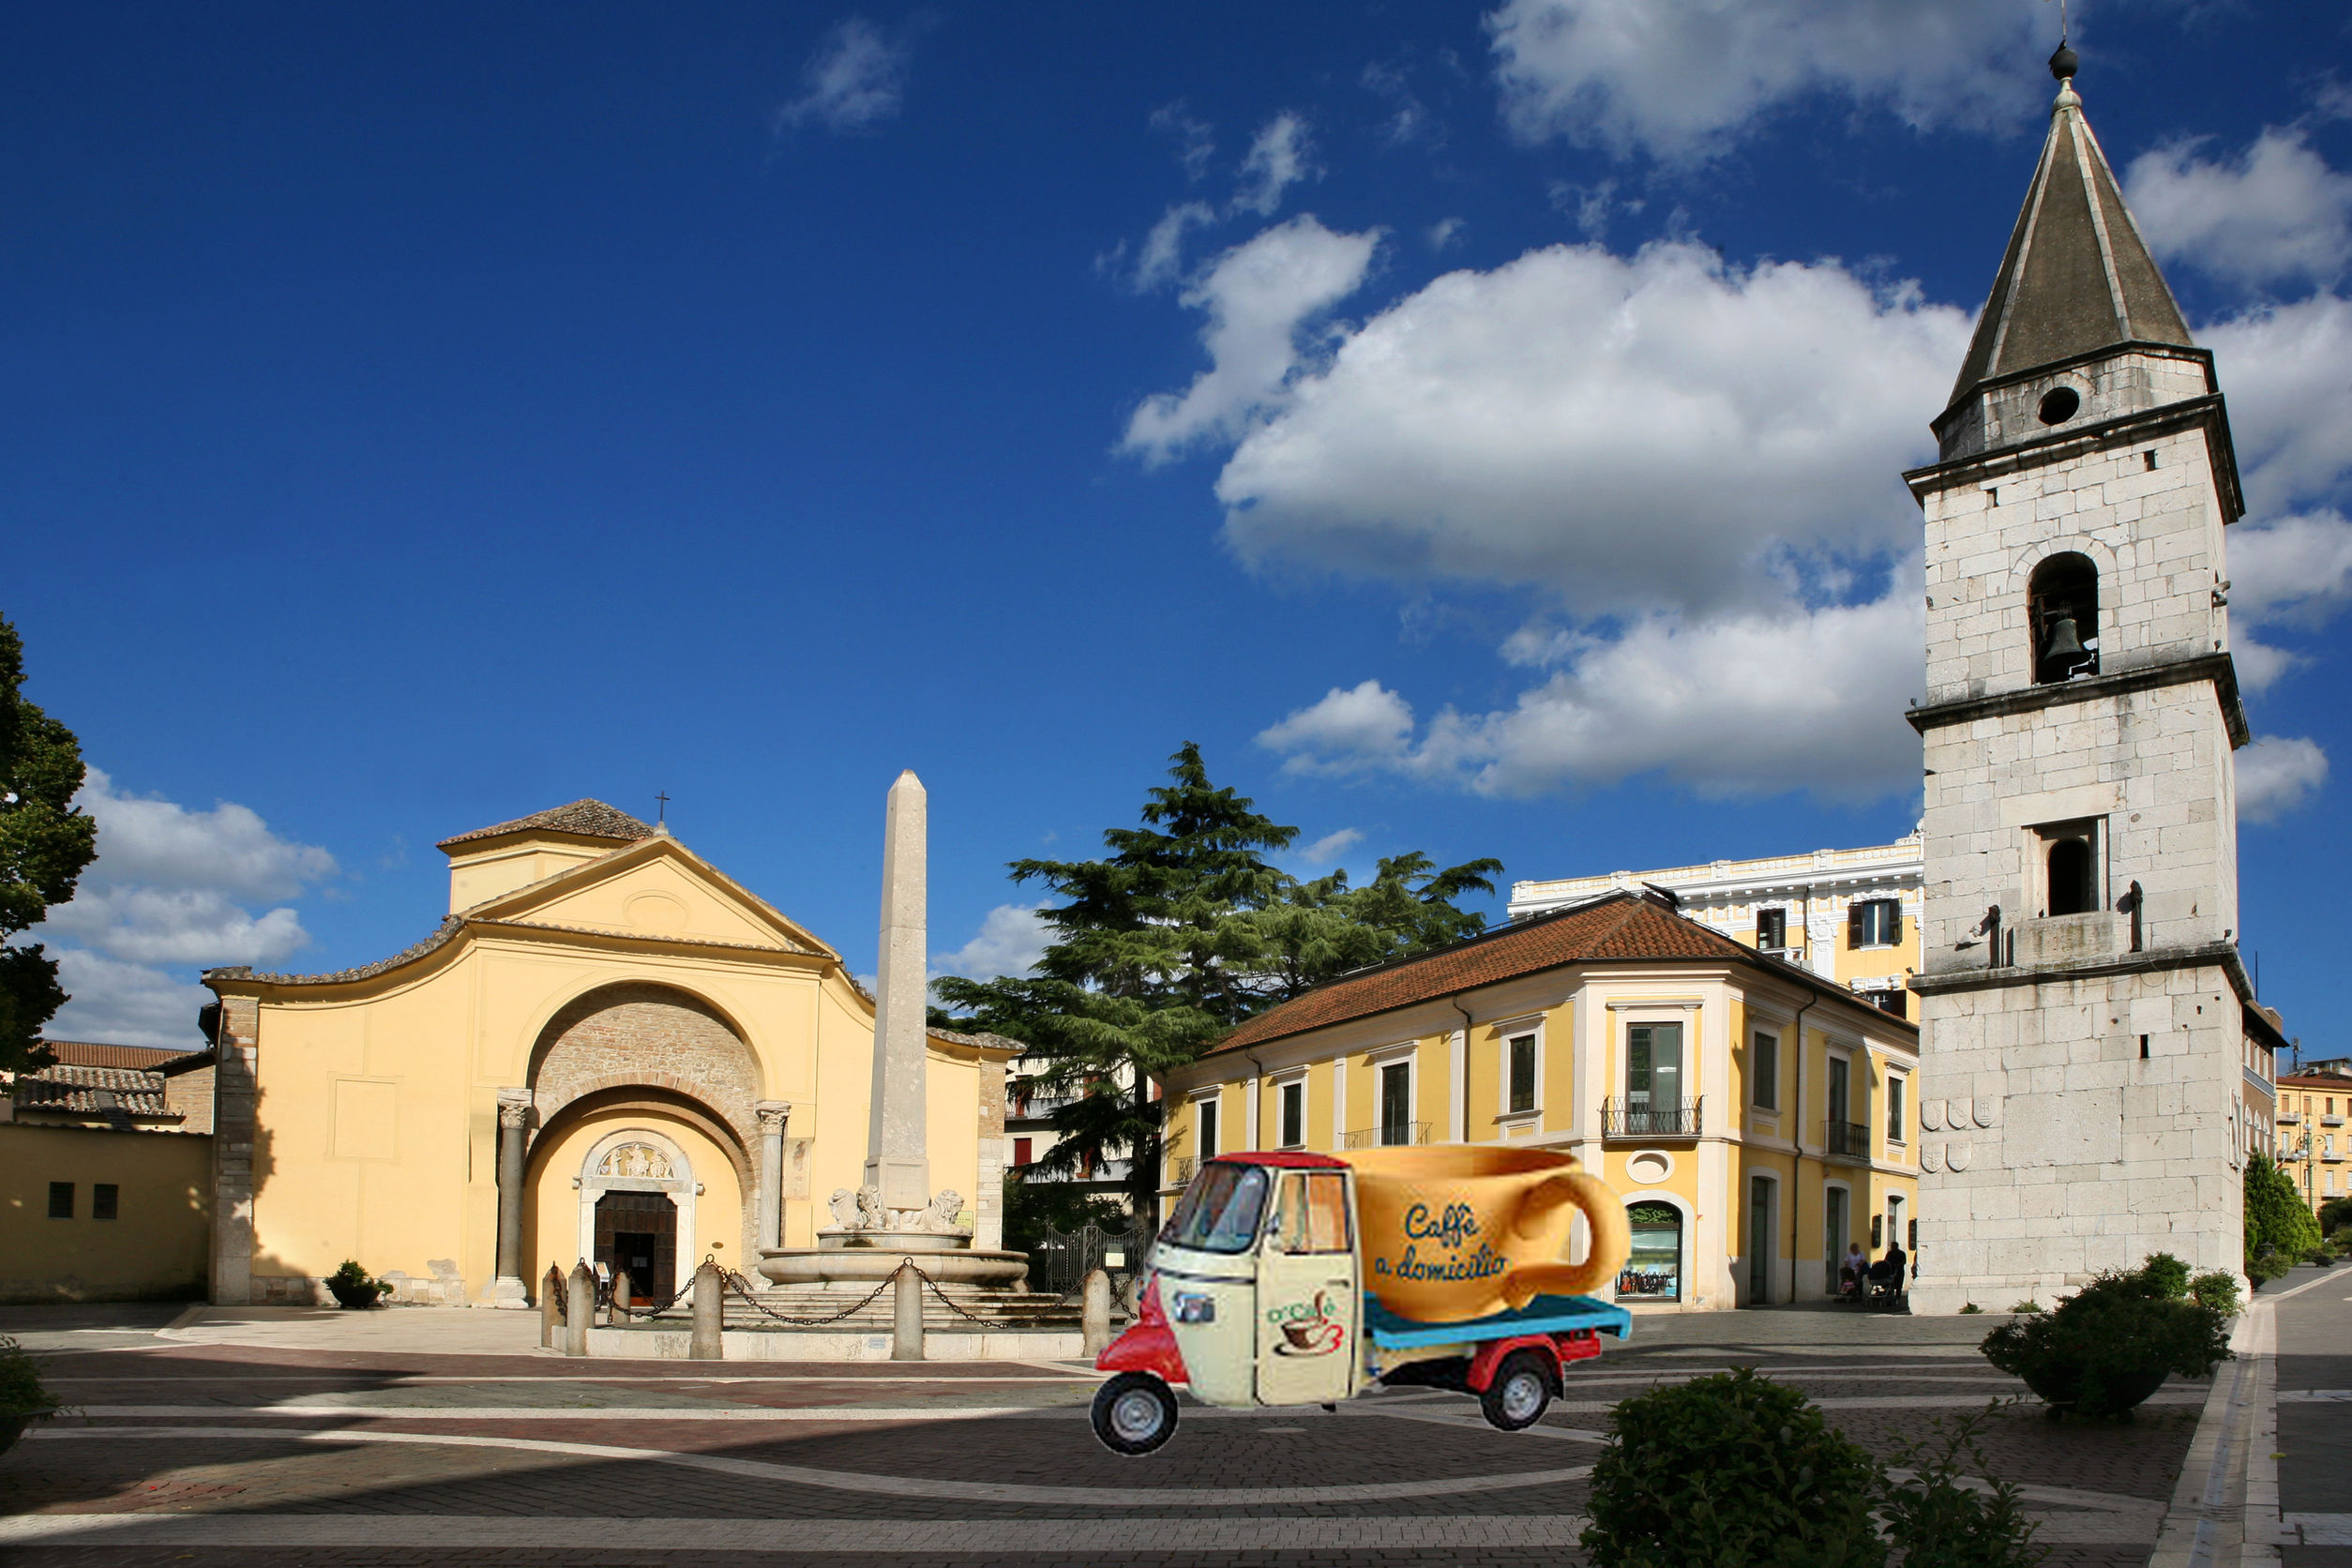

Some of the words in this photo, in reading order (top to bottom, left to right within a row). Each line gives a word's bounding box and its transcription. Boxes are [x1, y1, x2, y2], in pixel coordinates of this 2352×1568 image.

[1406, 1203, 1479, 1247] Caffè
[1375, 1258, 1392, 1274] a
[1397, 1244, 1507, 1280] domicilio
